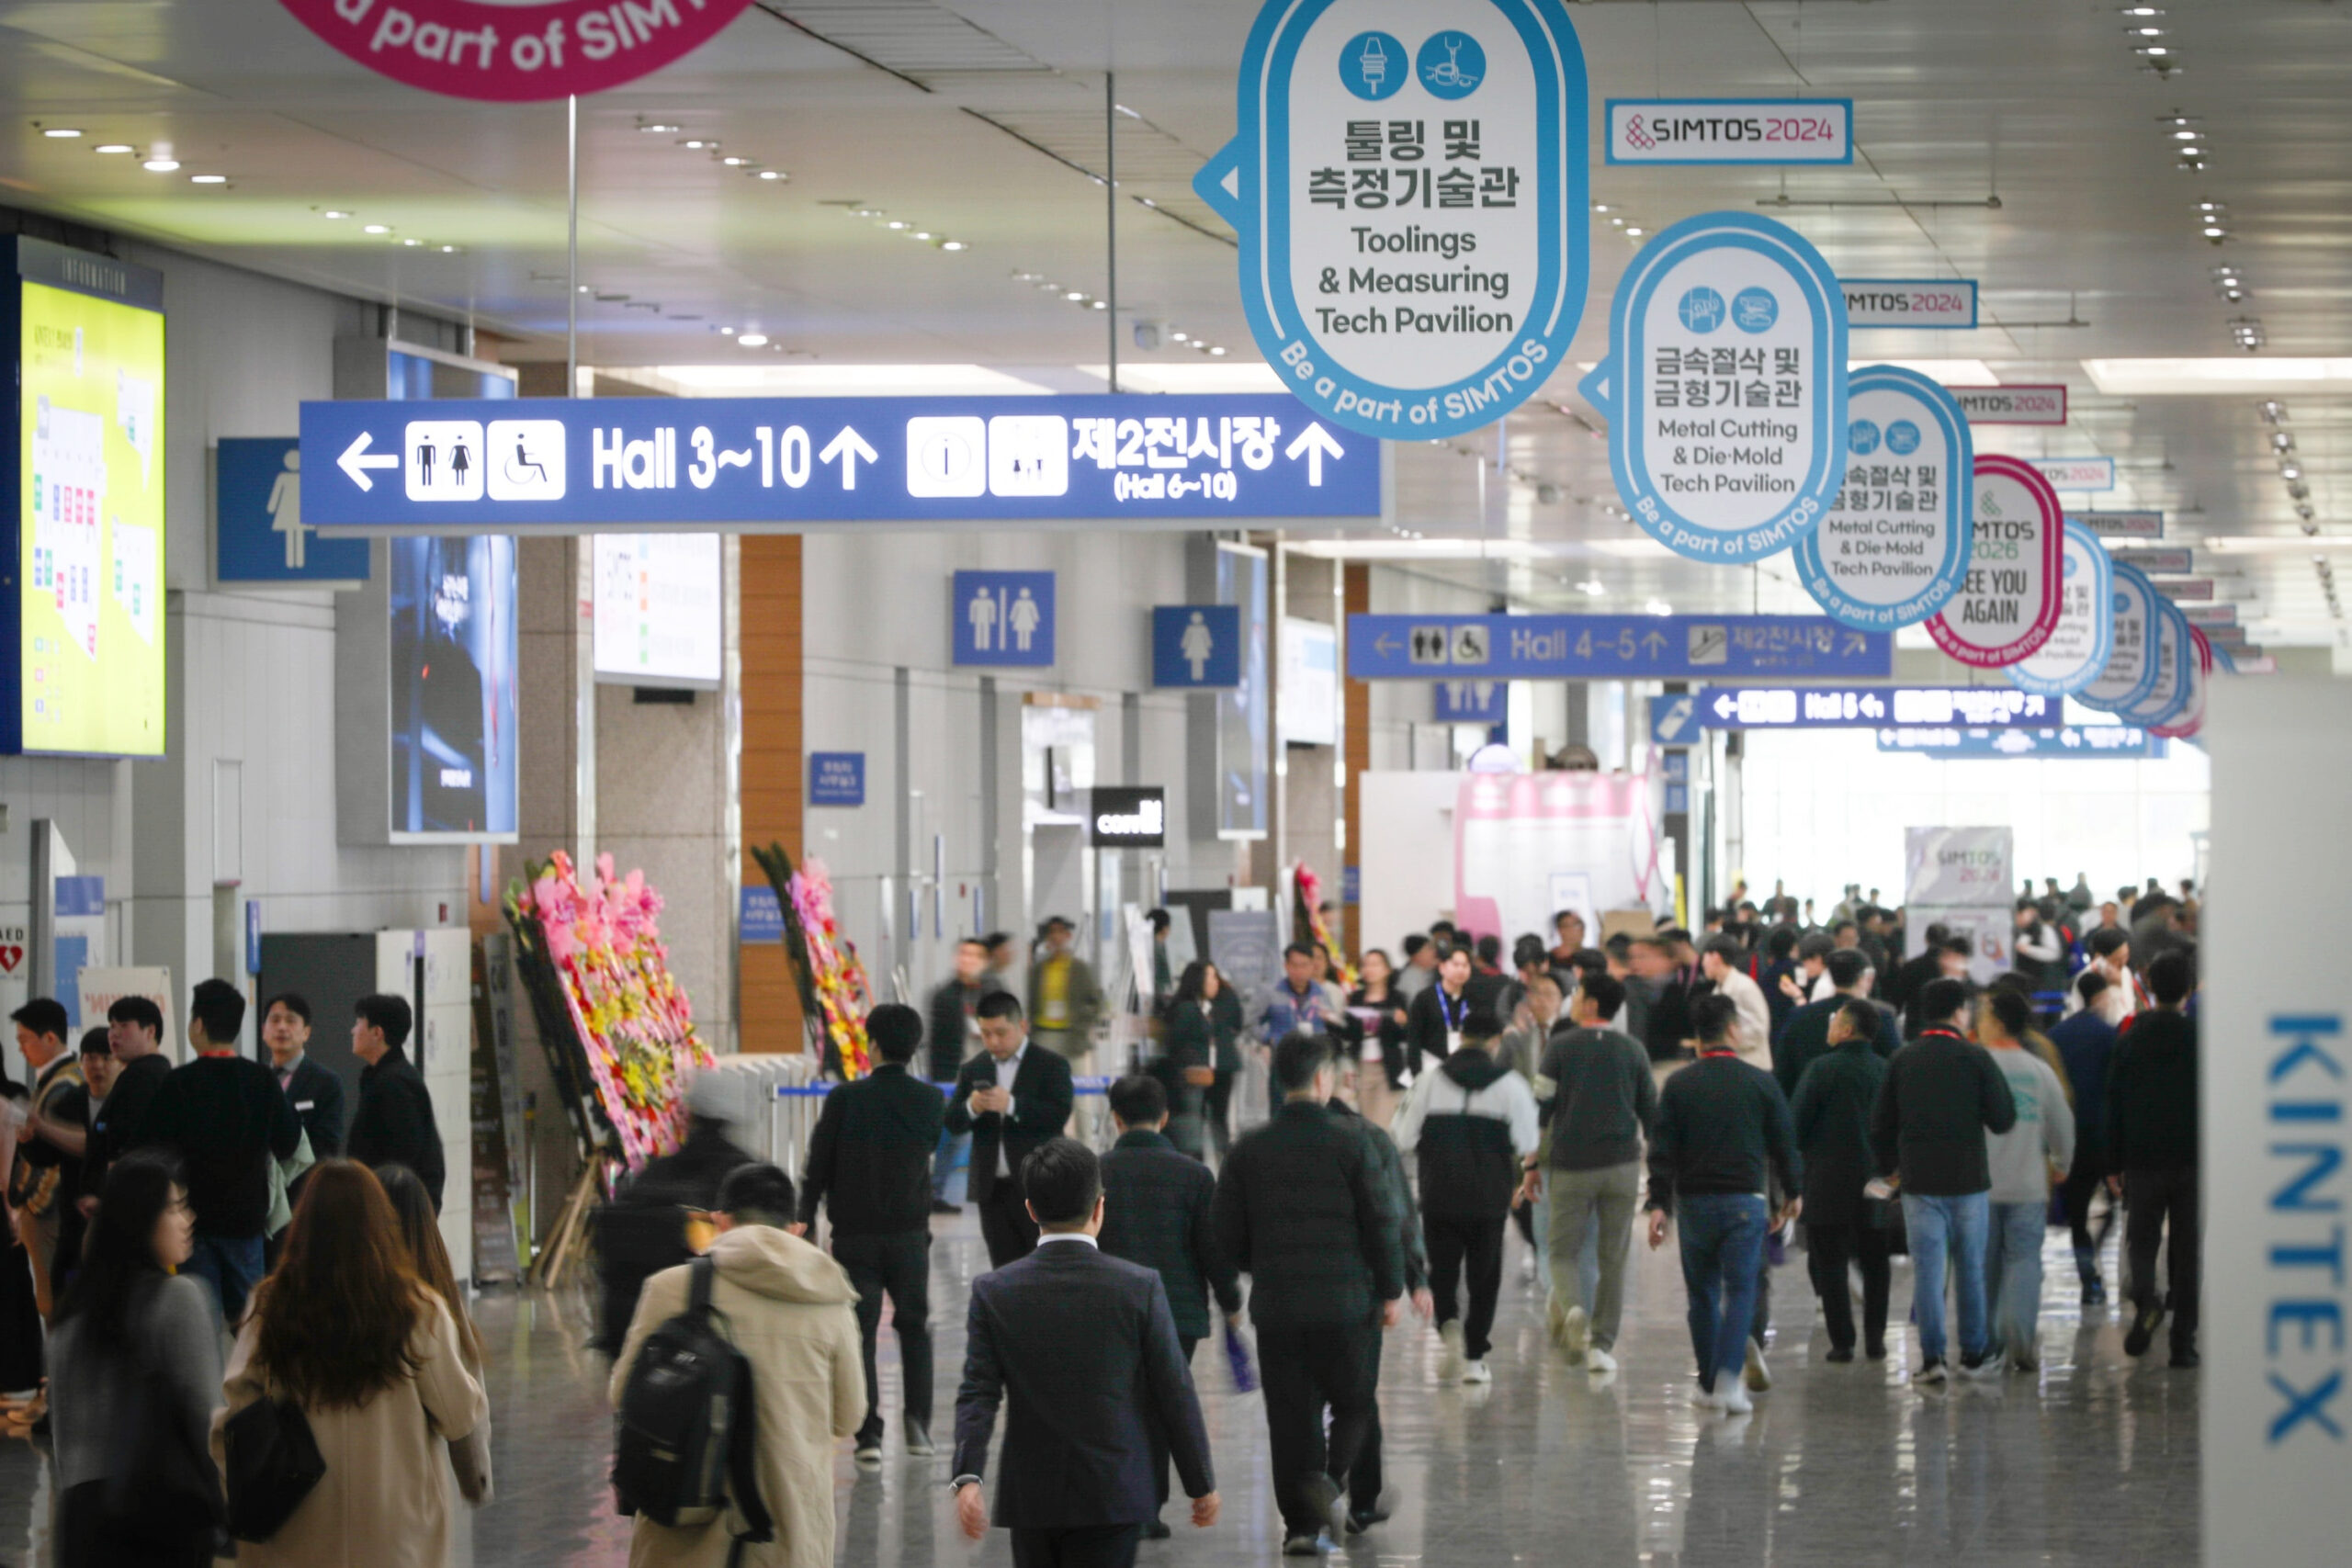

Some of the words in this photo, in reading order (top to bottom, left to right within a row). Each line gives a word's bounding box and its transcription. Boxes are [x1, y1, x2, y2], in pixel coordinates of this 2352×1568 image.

[369, 7, 499, 70] part
[511, 18, 566, 72] of
[575, 0, 706, 61] SIM
[1344, 119, 1425, 162] 툴링
[1443, 118, 1481, 161] 및
[1653, 118, 1762, 141] SIMTOS
[1765, 118, 1834, 141] 2024
[1308, 165, 1520, 210] 측정기술관
[1351, 225, 1477, 260] Toolings
[1318, 266, 1340, 294] &
[1349, 265, 1510, 299] Measuring
[1844, 293, 1909, 312] MTOS
[1912, 293, 1963, 312] 2024
[1315, 305, 1387, 333] Tech
[1395, 304, 1514, 333] Pavilion
[1655, 346, 1766, 376] 금속절삭
[1773, 347, 1800, 376] 및
[1280, 339, 1315, 380] Be
[1314, 377, 1337, 400] a
[1334, 389, 1403, 423] part
[1408, 396, 1439, 425] of
[1443, 338, 1549, 419] SIMTOS
[1654, 378, 1803, 408] 금형기술관
[2014, 395, 2056, 412] 2024
[1072, 416, 1281, 471] 제2전시장
[1657, 419, 1715, 438] Metal
[1720, 418, 1798, 443] Cutting
[593, 426, 676, 490] Hall
[688, 424, 810, 490] 3~10
[1672, 446, 1688, 466] &
[1660, 473, 1710, 492] Tech
[1714, 473, 1796, 492] Pavilion
[1841, 465, 1911, 488] 속절삭
[1917, 465, 1937, 488] 및
[1635, 495, 1660, 524] Be
[1658, 520, 1674, 536] a
[1672, 529, 1720, 555] part
[1724, 535, 1744, 555] of
[1747, 496, 1819, 551] SIMTOS
[1829, 520, 1873, 536] Metal
[1876, 520, 1936, 538] Cutting
[1972, 521, 2034, 540] MTOS
[1839, 539, 1852, 556] &
[1831, 560, 1868, 577] Tech
[1871, 560, 1933, 577] Pavilion
[1990, 569, 2028, 595] YOU
[1839, 604, 1876, 624] part
[1878, 607, 1894, 624] of
[1896, 578, 1951, 621] SIMTOS
[1962, 599, 2019, 625] AGAIN
[1511, 628, 1566, 660] Hall
[2265, 1014, 2345, 1445] KINTEX
